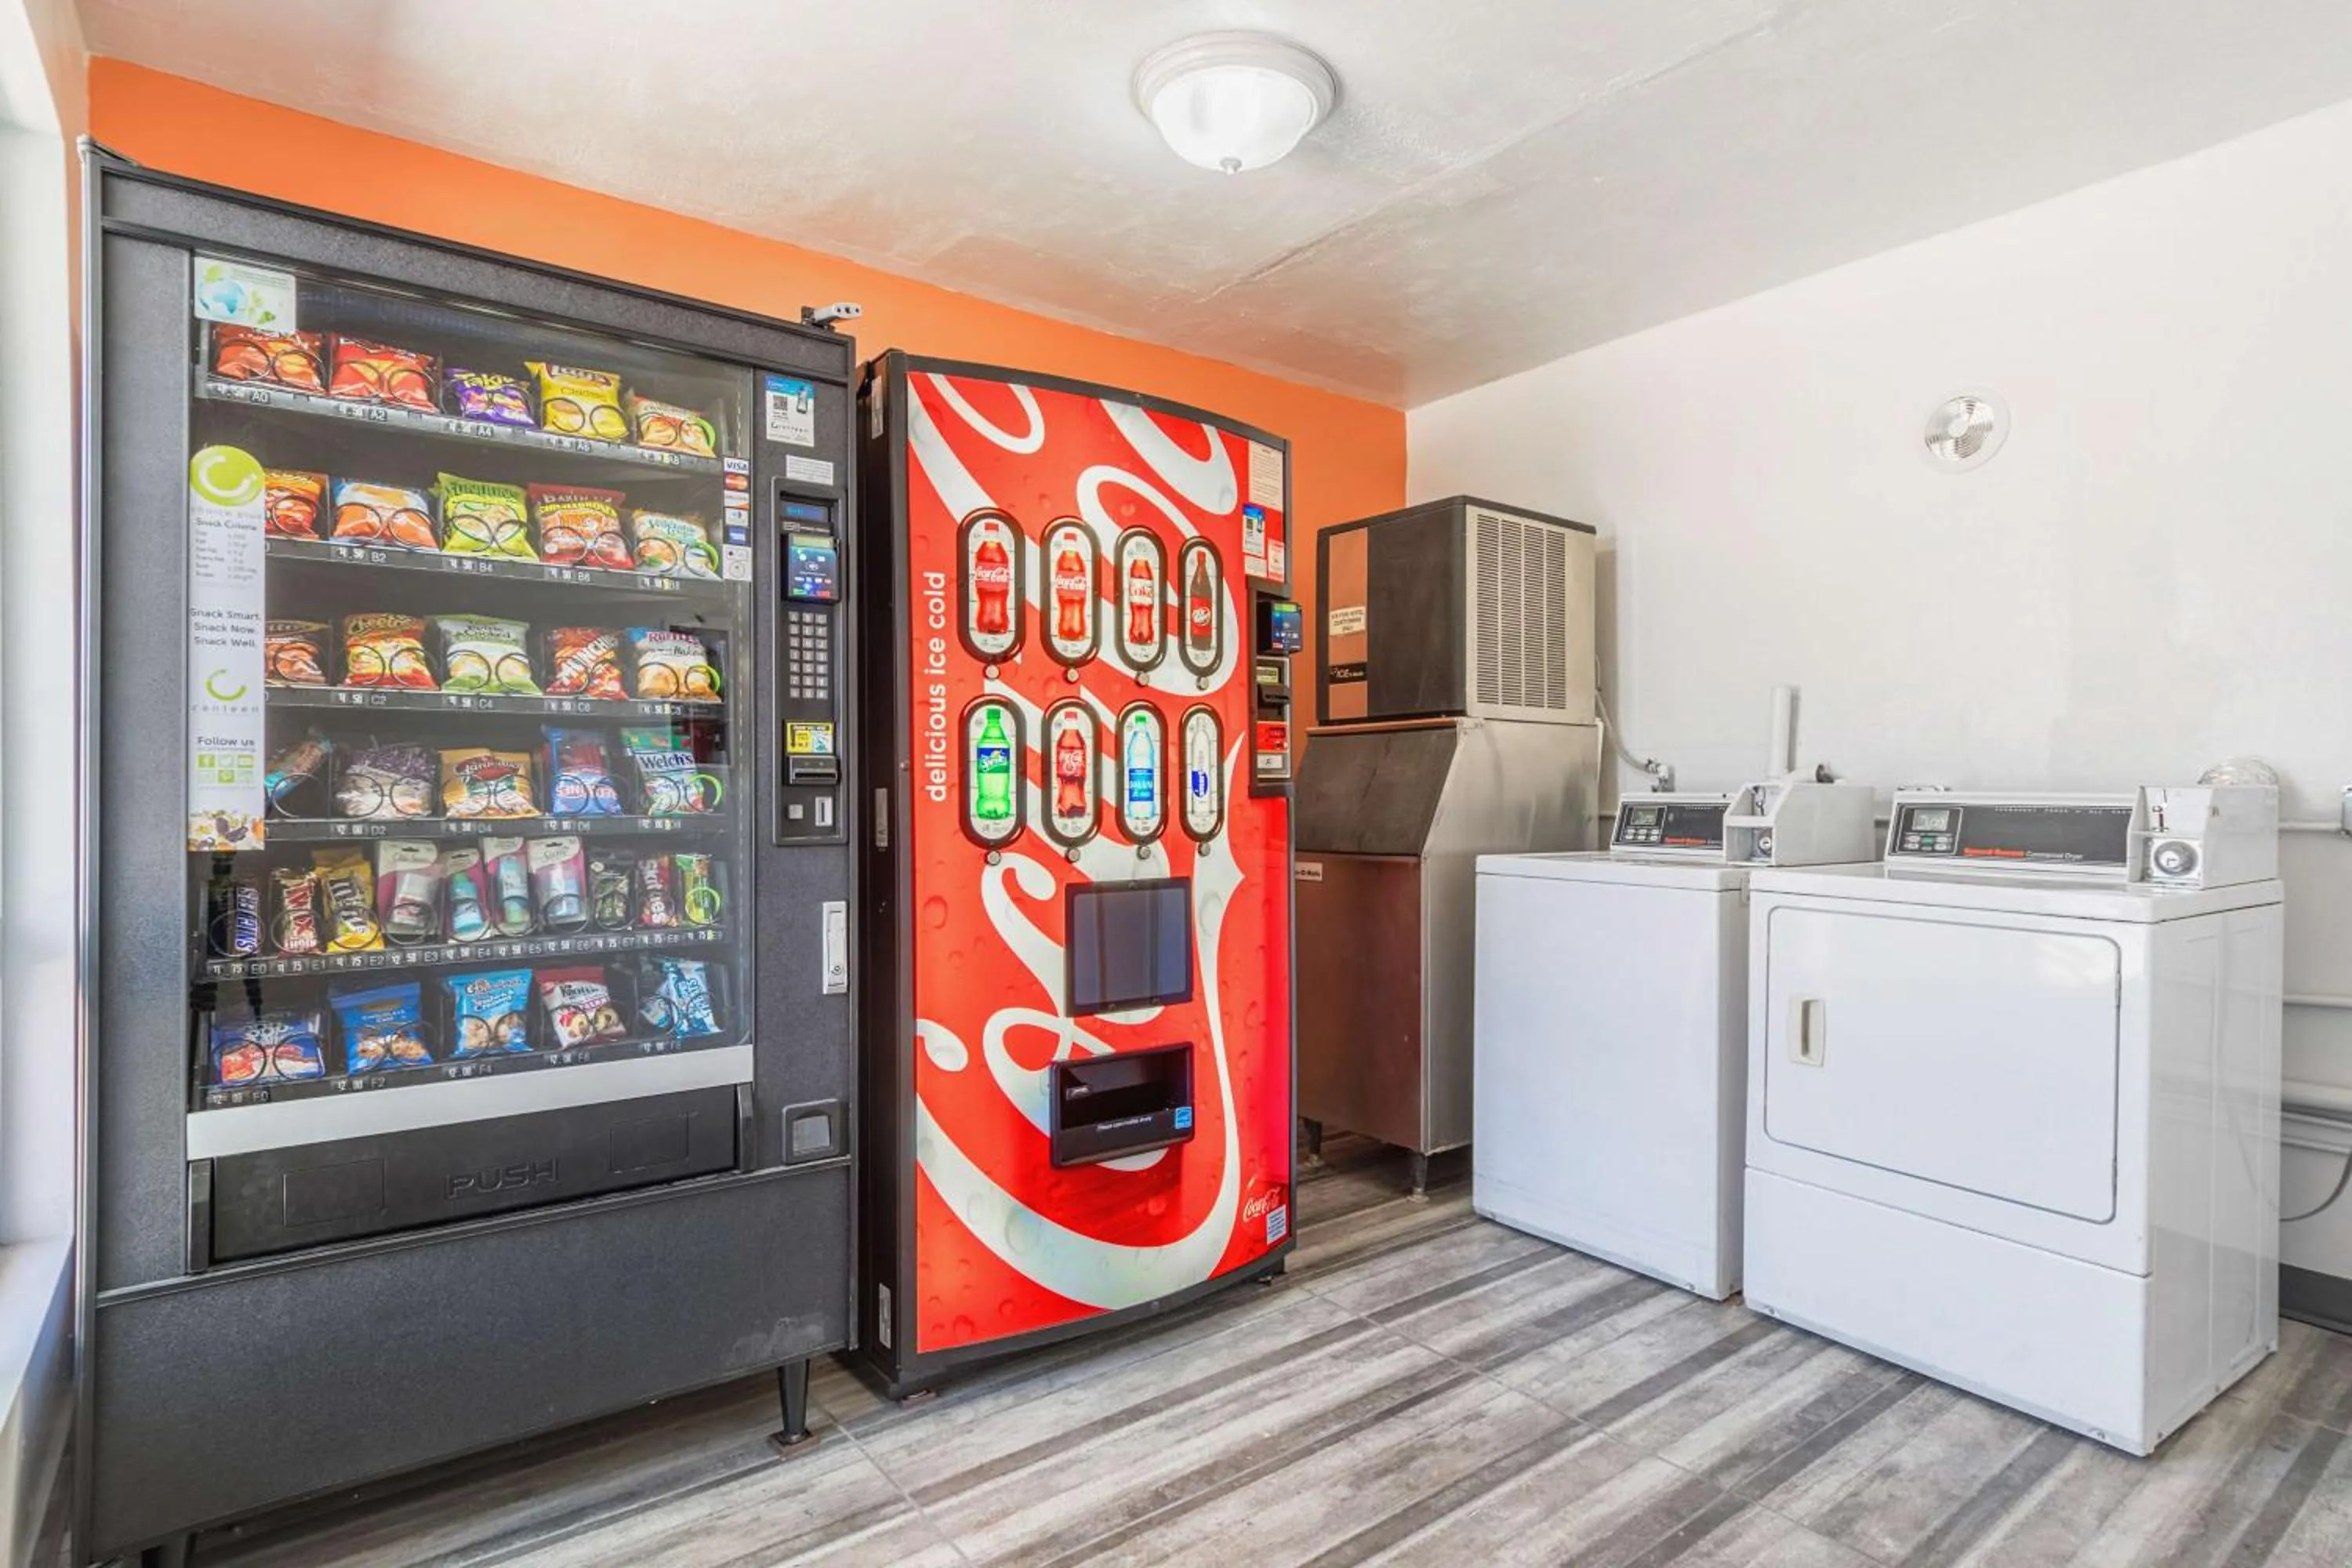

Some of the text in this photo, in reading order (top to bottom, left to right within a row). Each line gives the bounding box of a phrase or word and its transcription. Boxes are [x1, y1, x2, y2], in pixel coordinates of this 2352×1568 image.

[727, 461, 747, 470] VISA
[371, 551, 387, 563] B2
[190, 608, 223, 617] Snack
[194, 622, 227, 632] Snack
[194, 636, 227, 645] Snack
[924, 572, 947, 802] delicious ice cold
[198, 736, 238, 746] Follow
[639, 753, 694, 769] Welch's
[235, 886, 259, 952] SNICKERS
[369, 956, 385, 967] E2
[424, 951, 439, 963] E3
[251, 963, 267, 975] E0
[370, 1076, 386, 1088] F2
[447, 1157, 559, 1198] PUSH
